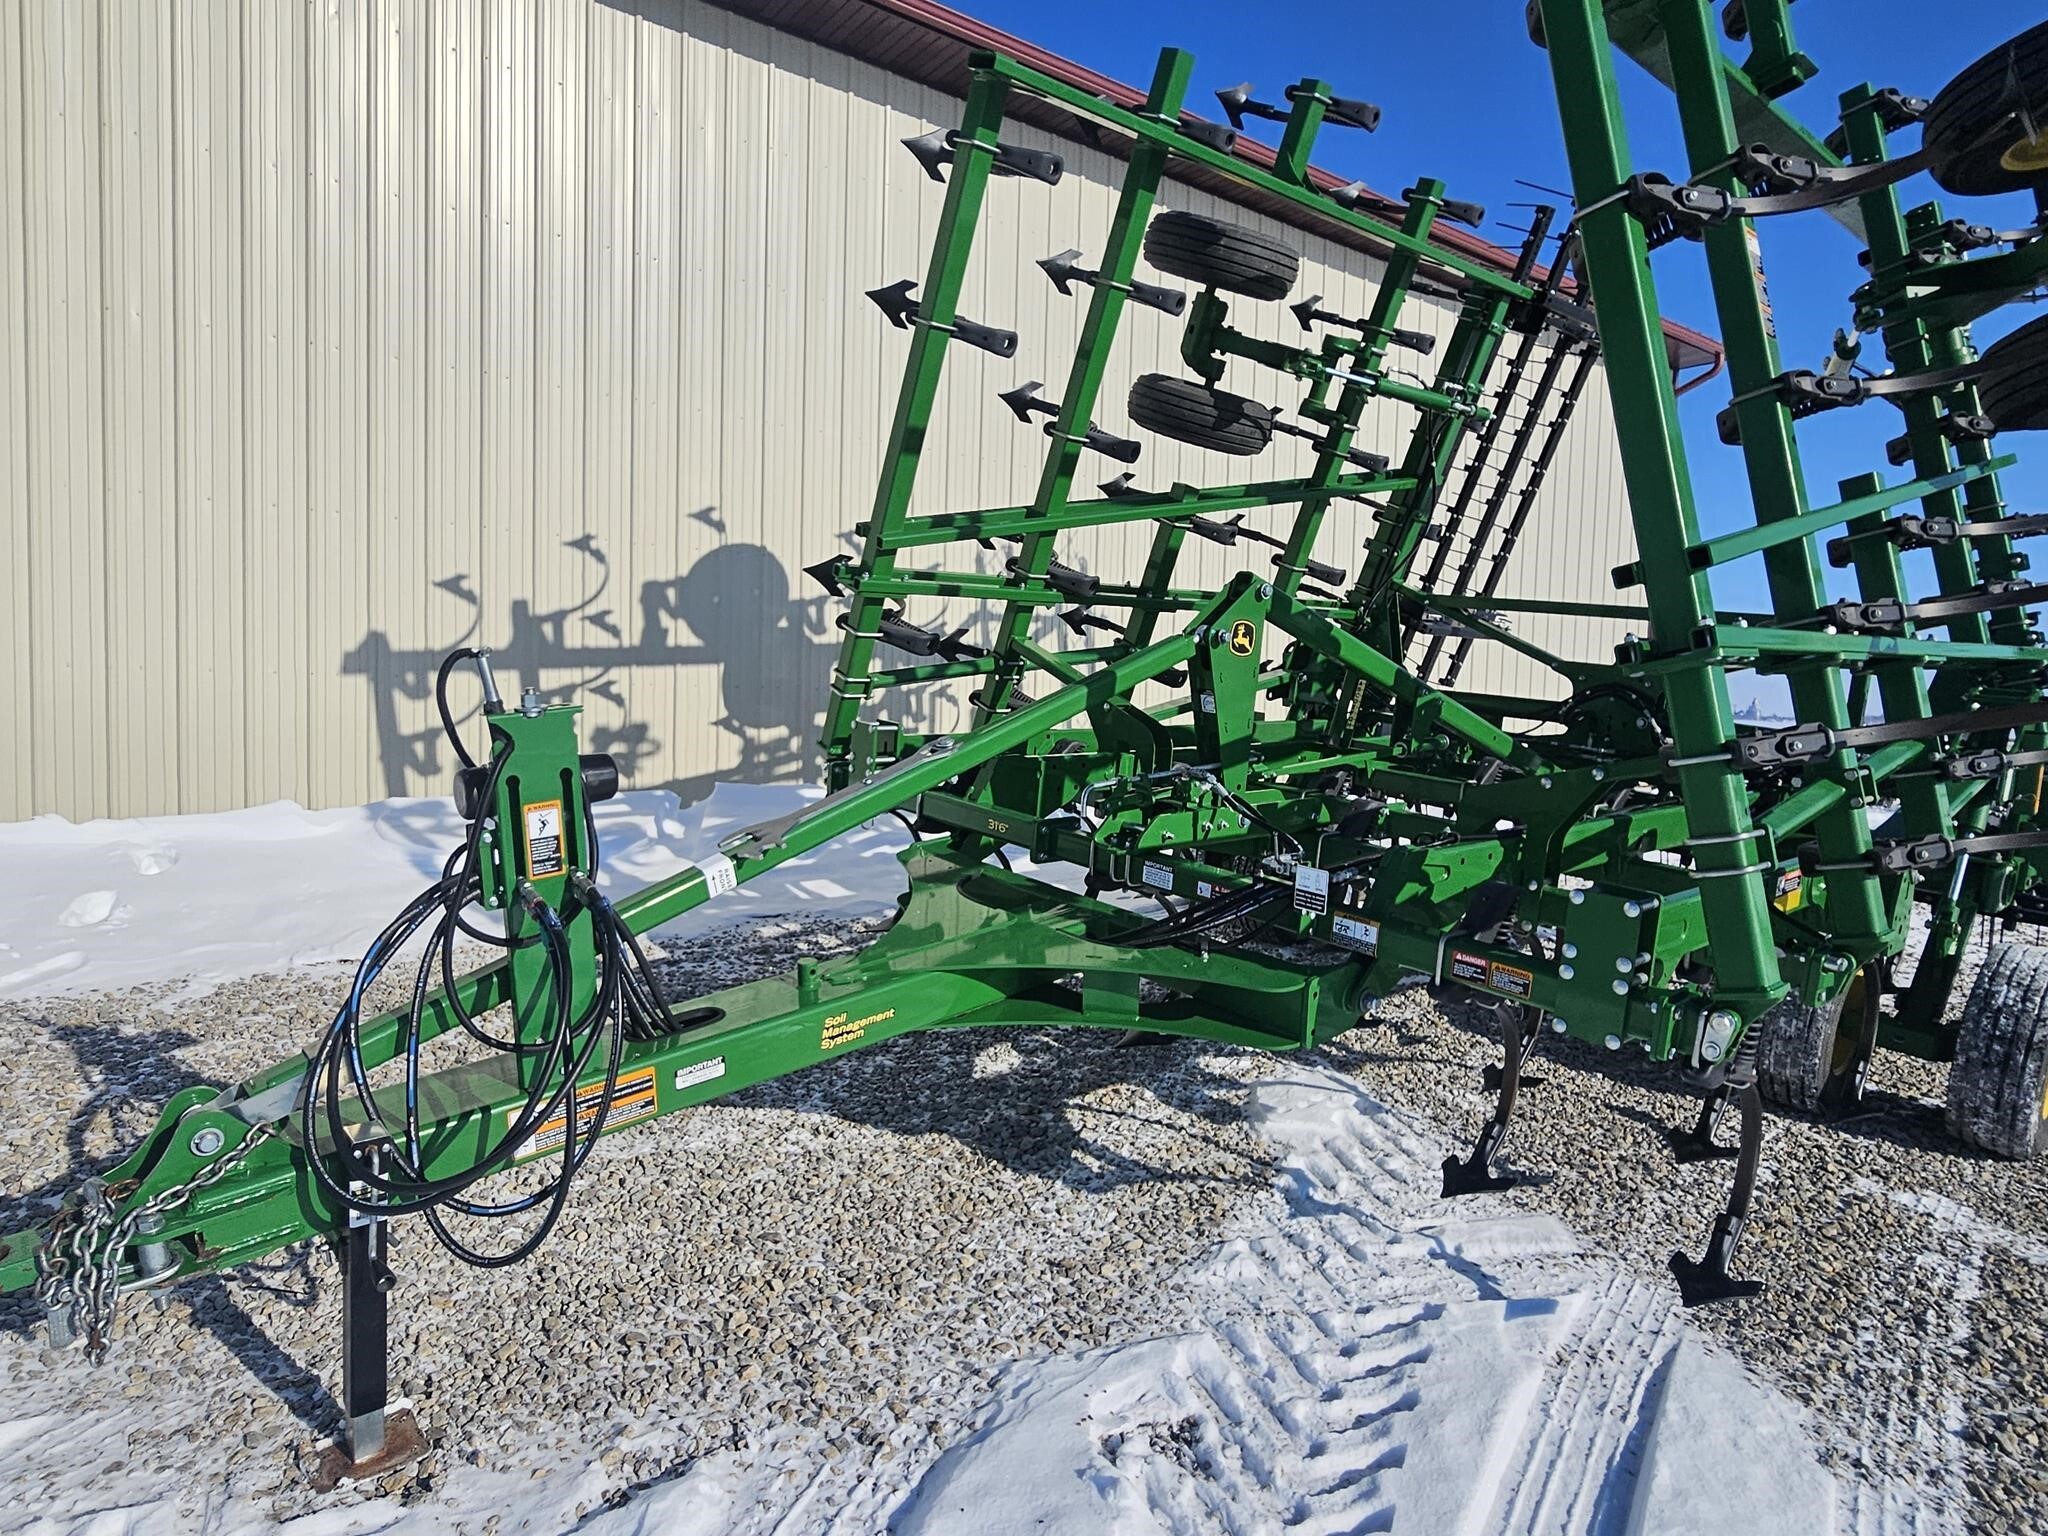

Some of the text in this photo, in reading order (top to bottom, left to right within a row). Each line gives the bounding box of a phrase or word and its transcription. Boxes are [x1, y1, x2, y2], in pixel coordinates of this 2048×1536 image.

[1144, 860, 1173, 873] IMPORTANT
[1462, 953, 1486, 967] DANGER
[1500, 965, 1531, 980] WARNING
[822, 1008, 896, 1039] Management
[824, 1012, 847, 1028] Soil
[820, 1029, 865, 1050] System
[677, 1055, 724, 1077] IMPORTANT
